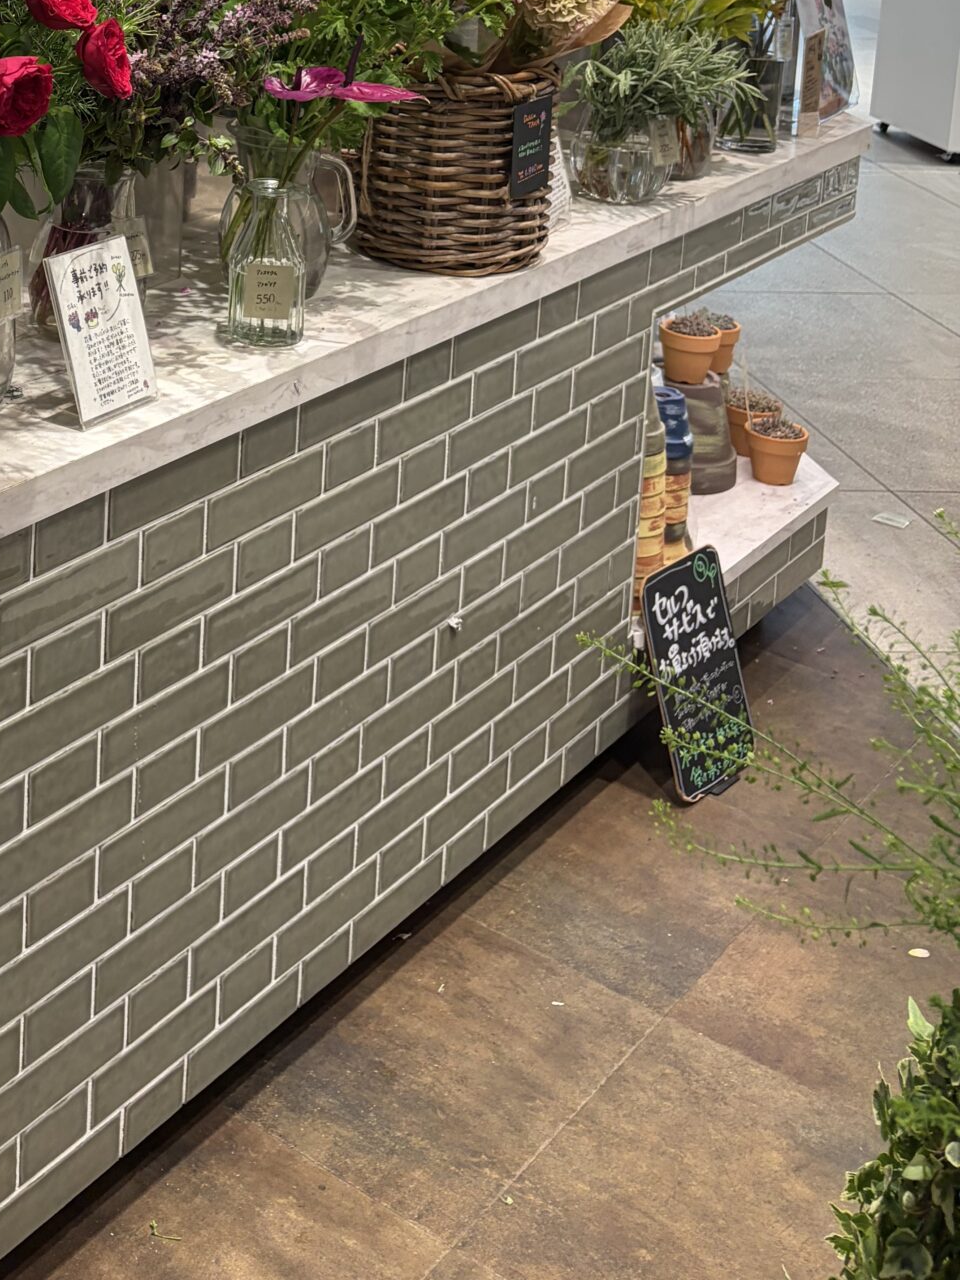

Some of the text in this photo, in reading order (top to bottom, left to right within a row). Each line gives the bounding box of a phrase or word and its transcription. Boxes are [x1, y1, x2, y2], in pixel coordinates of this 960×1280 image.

[70, 262, 108, 289] 事前ご予約
[256, 293, 276, 305] 550
[652, 585, 690, 625] セルフ
[663, 596, 718, 642] サービスで
